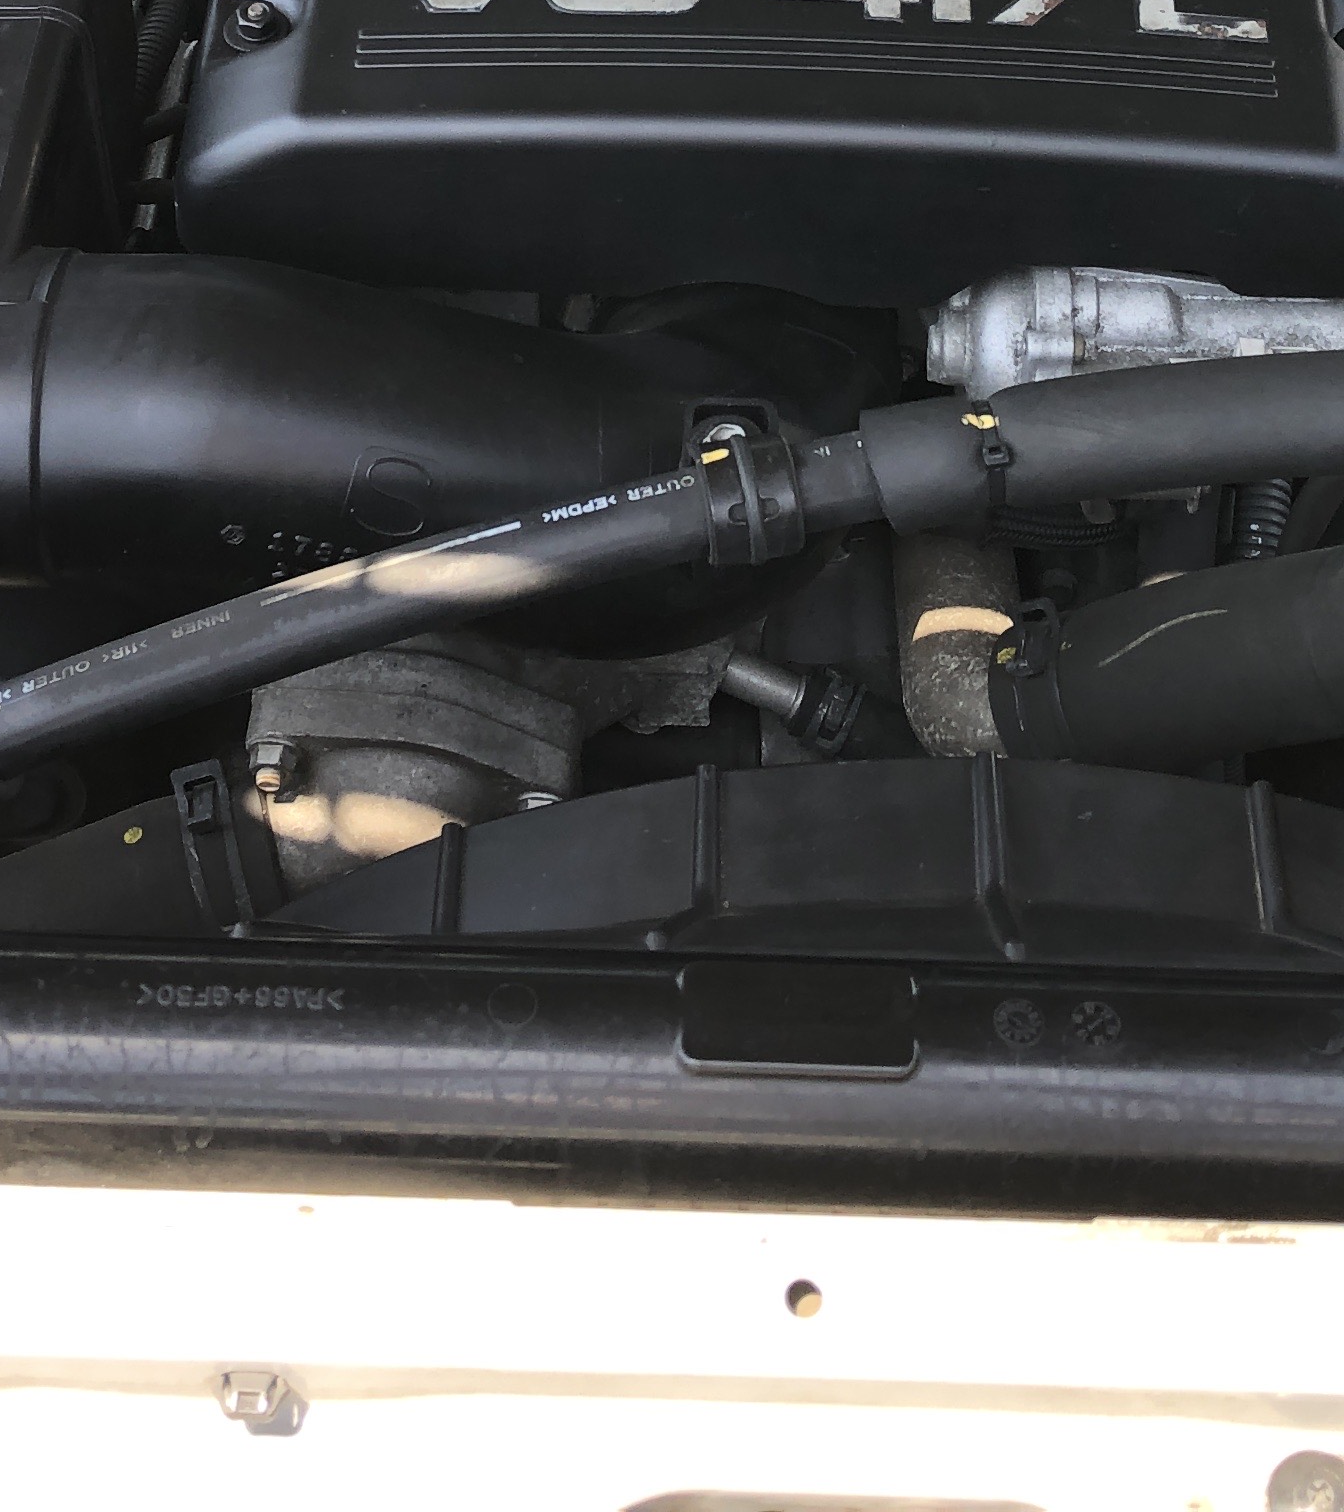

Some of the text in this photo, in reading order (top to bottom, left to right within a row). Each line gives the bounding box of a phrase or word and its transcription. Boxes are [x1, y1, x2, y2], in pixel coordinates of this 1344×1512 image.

[626, 475, 695, 502] OUTER
[171, 609, 231, 639] INNER
[22, 660, 91, 694] OUTER
